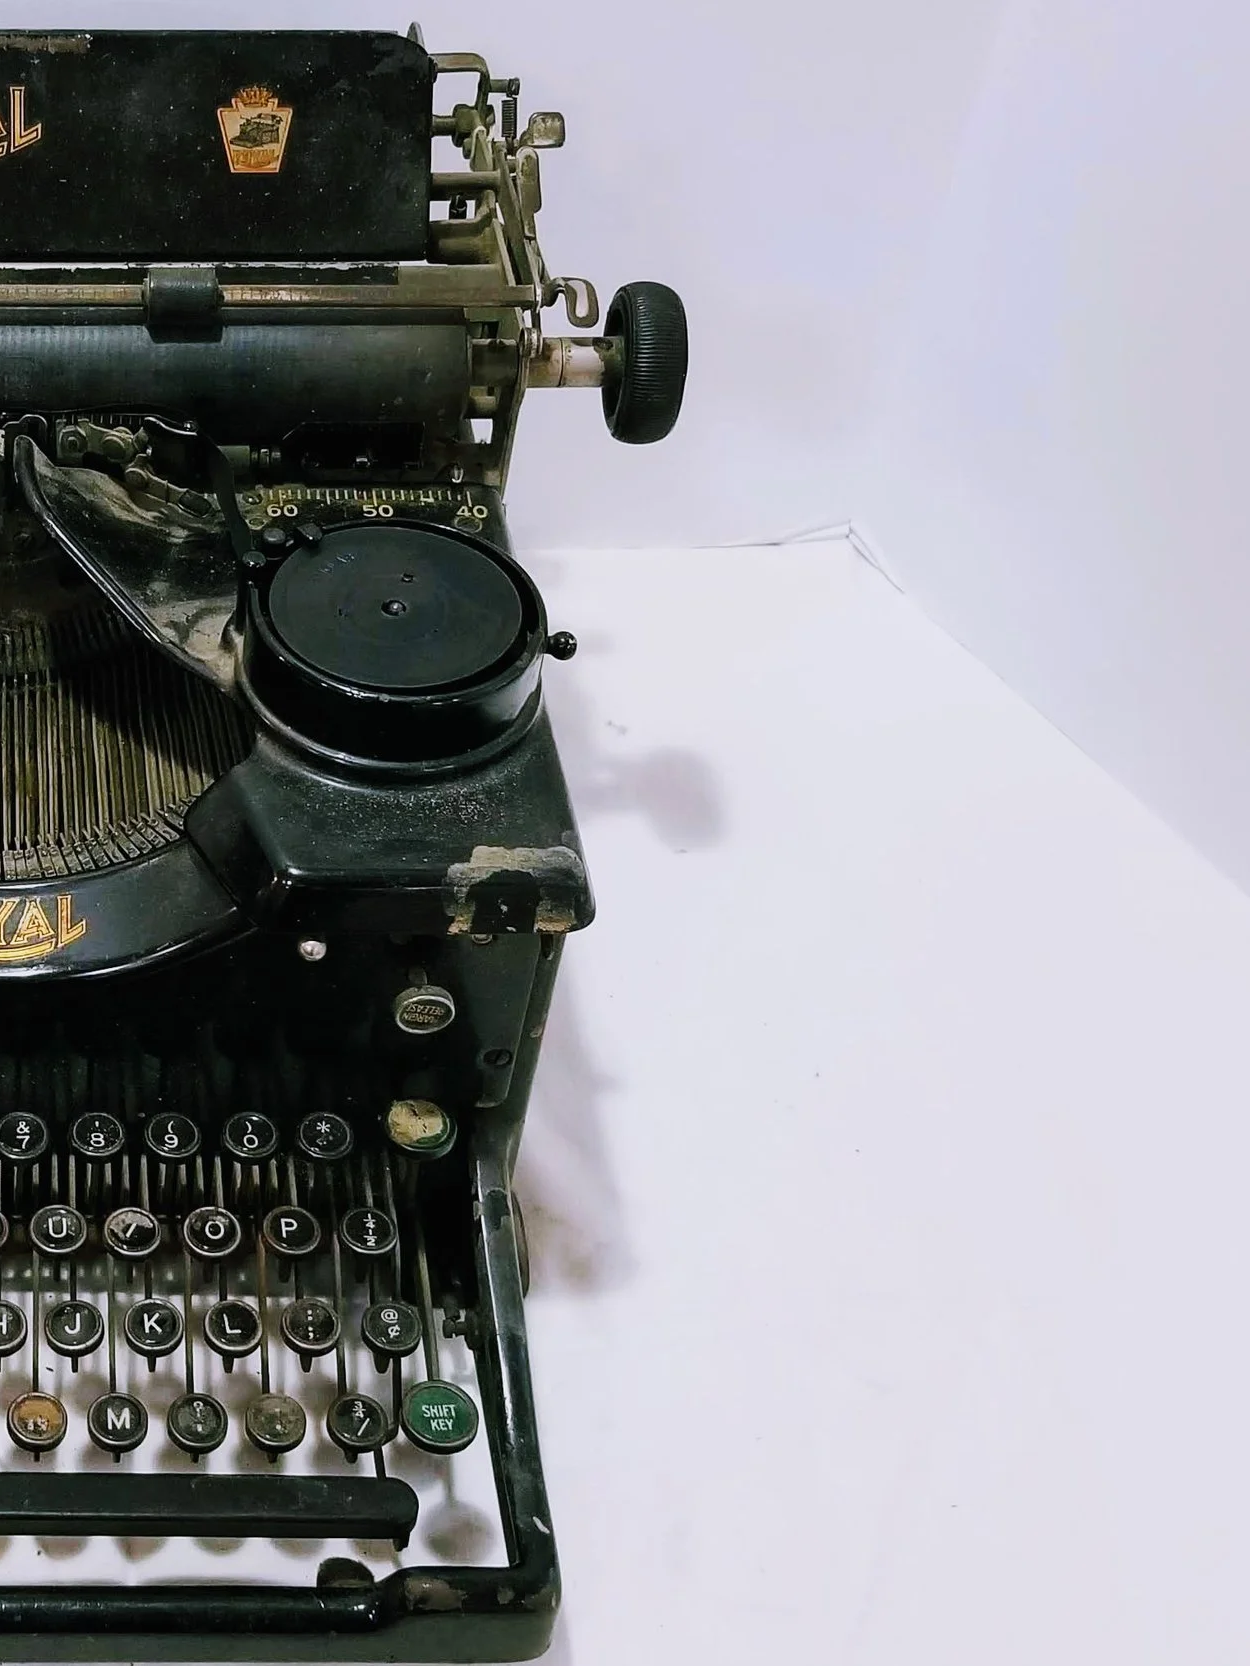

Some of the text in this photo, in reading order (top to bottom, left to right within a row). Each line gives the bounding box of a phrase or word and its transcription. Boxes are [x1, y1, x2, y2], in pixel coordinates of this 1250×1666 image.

[266, 504, 488, 518] 60 50 40
[17, 1121, 30, 1134] &
[16, 1135, 30, 1149] 7
[90, 1133, 105, 1147] 8
[164, 1134, 179, 1148] 9
[48, 1217, 67, 1238] U
[205, 1220, 225, 1240] O
[281, 1218, 297, 1238] P
[143, 1312, 162, 1334] K
[381, 1309, 398, 1323] @
[64, 1312, 81, 1335] J
[223, 1314, 241, 1334] L
[421, 1405, 456, 1418] SHIFT
[107, 1408, 130, 1430] M
[430, 1418, 454, 1431] KEY
